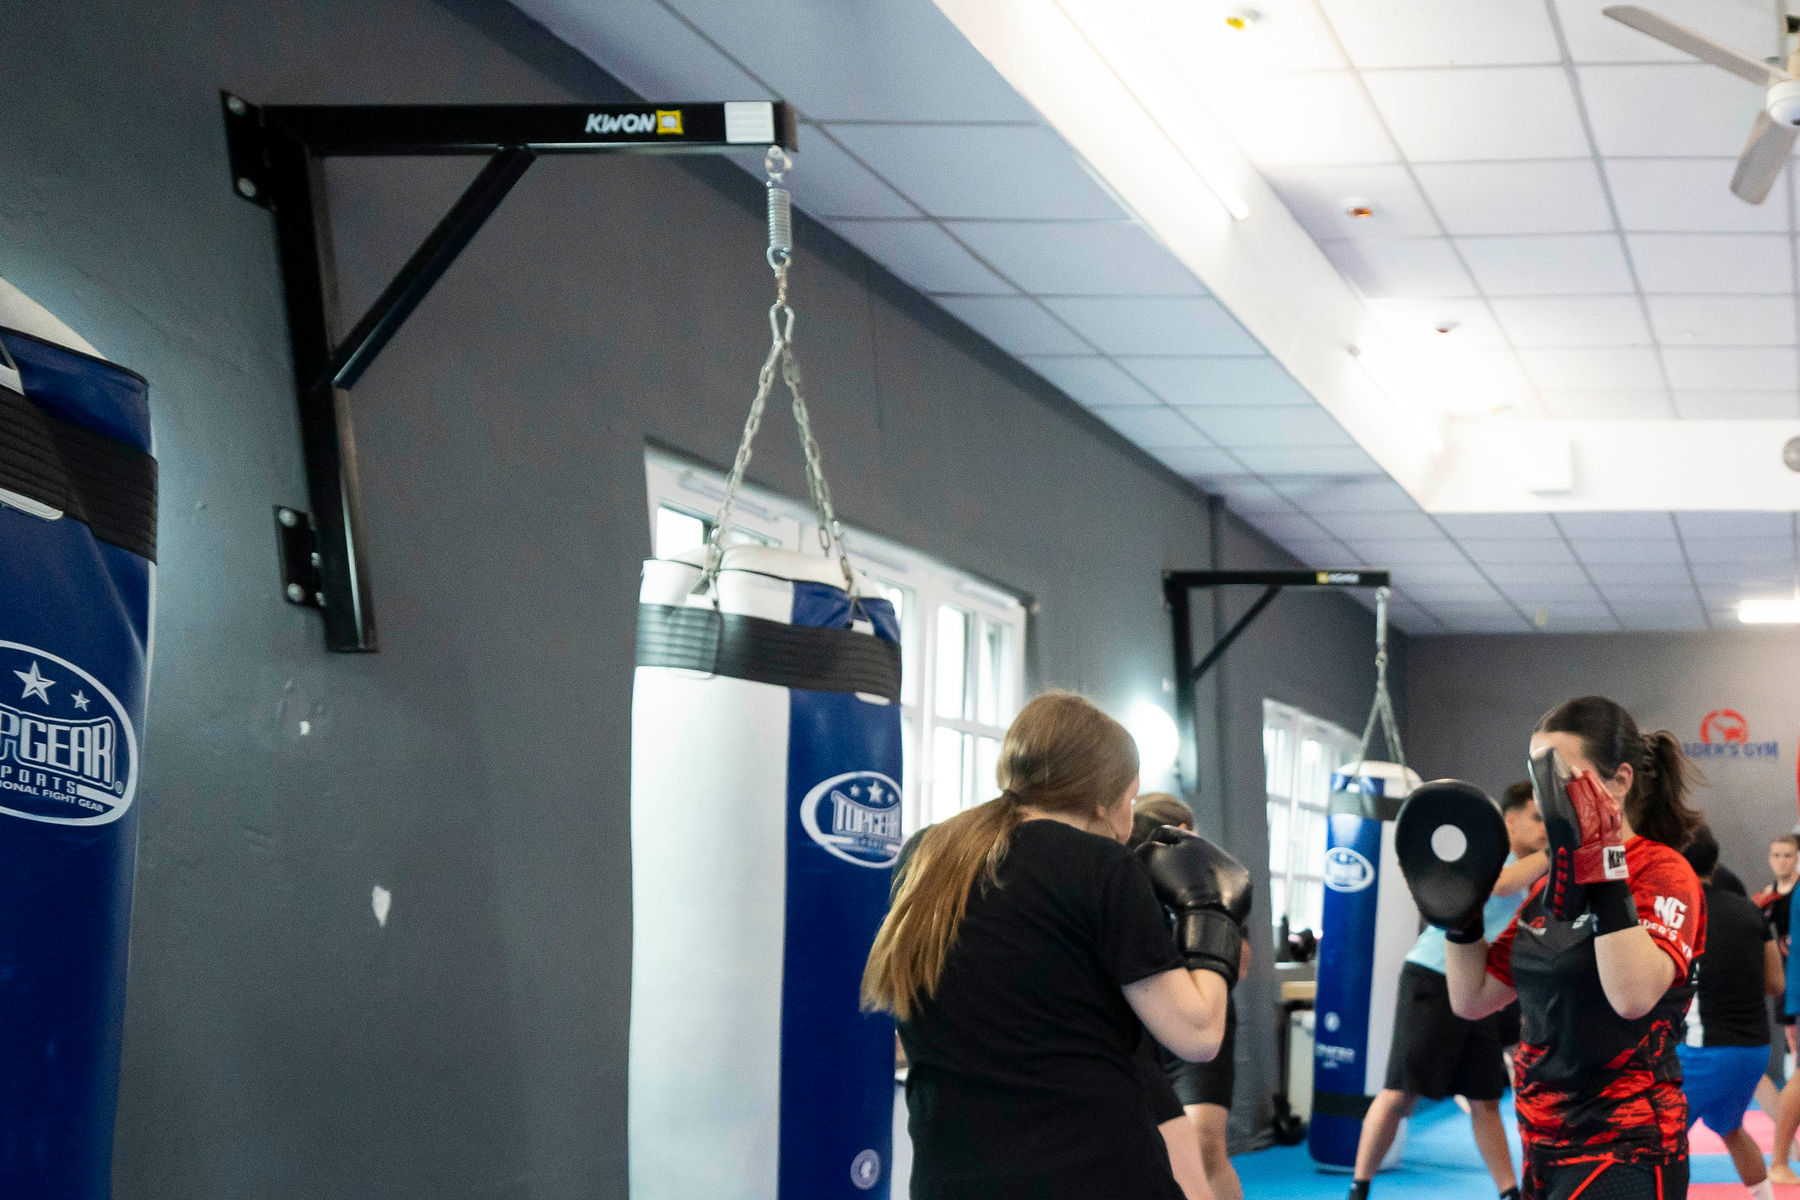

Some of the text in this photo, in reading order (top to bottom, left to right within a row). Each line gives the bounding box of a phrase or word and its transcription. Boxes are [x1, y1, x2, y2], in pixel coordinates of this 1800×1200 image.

[584, 112, 657, 134] KWON
[42, 789, 77, 804] FIGHT
[78, 798, 104, 812] GEAR
